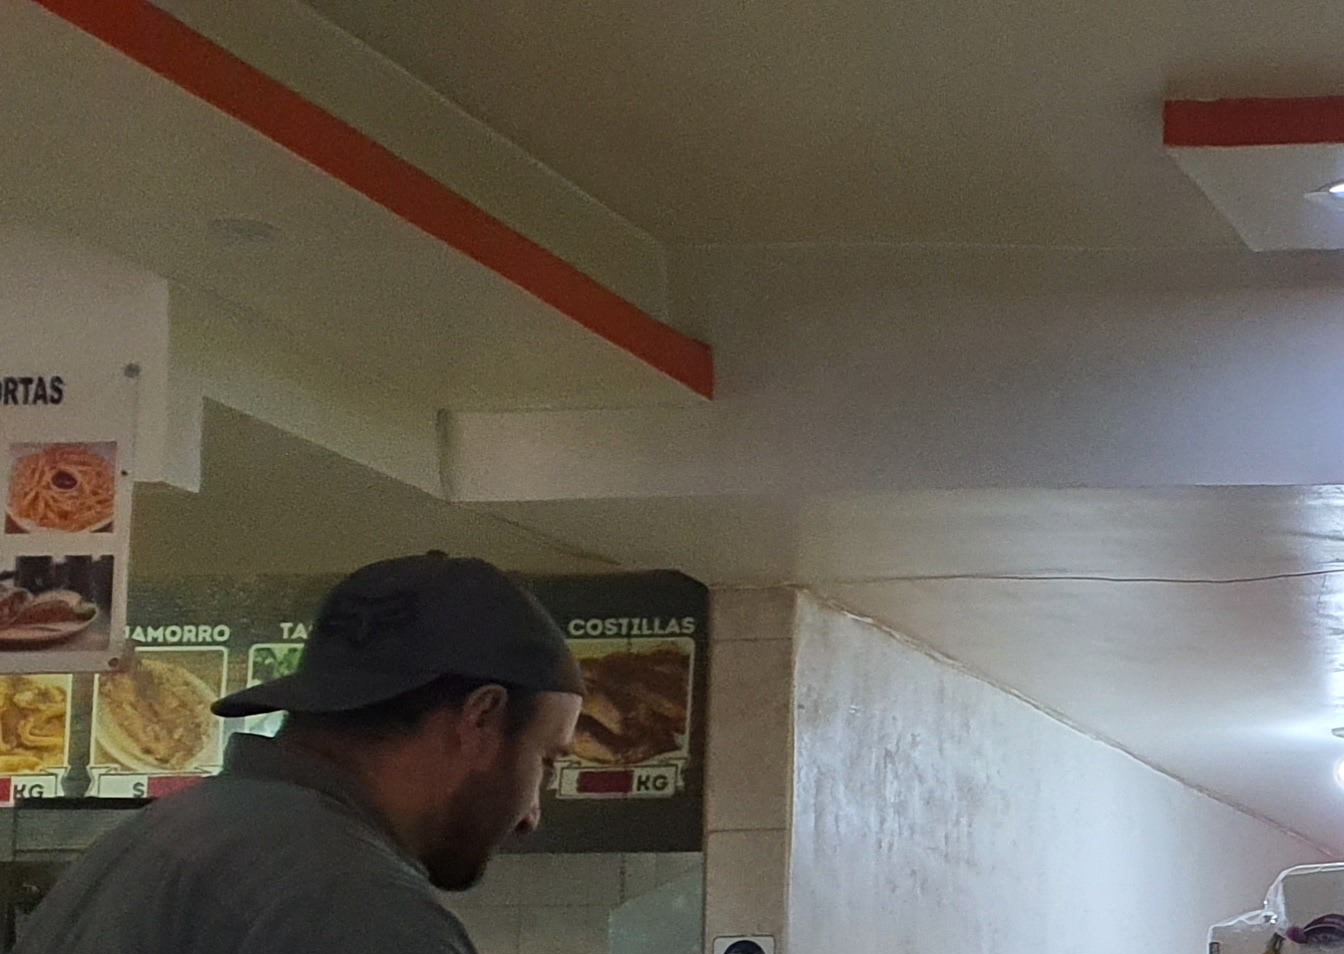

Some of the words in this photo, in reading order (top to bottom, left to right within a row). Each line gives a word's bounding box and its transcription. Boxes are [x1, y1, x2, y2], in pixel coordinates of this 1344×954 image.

[0, 376, 66, 405] RTAS
[125, 625, 230, 642] AMORRO
[280, 622, 313, 640] TA
[568, 617, 696, 636] COSTILLAS
[637, 775, 668, 791] KG
